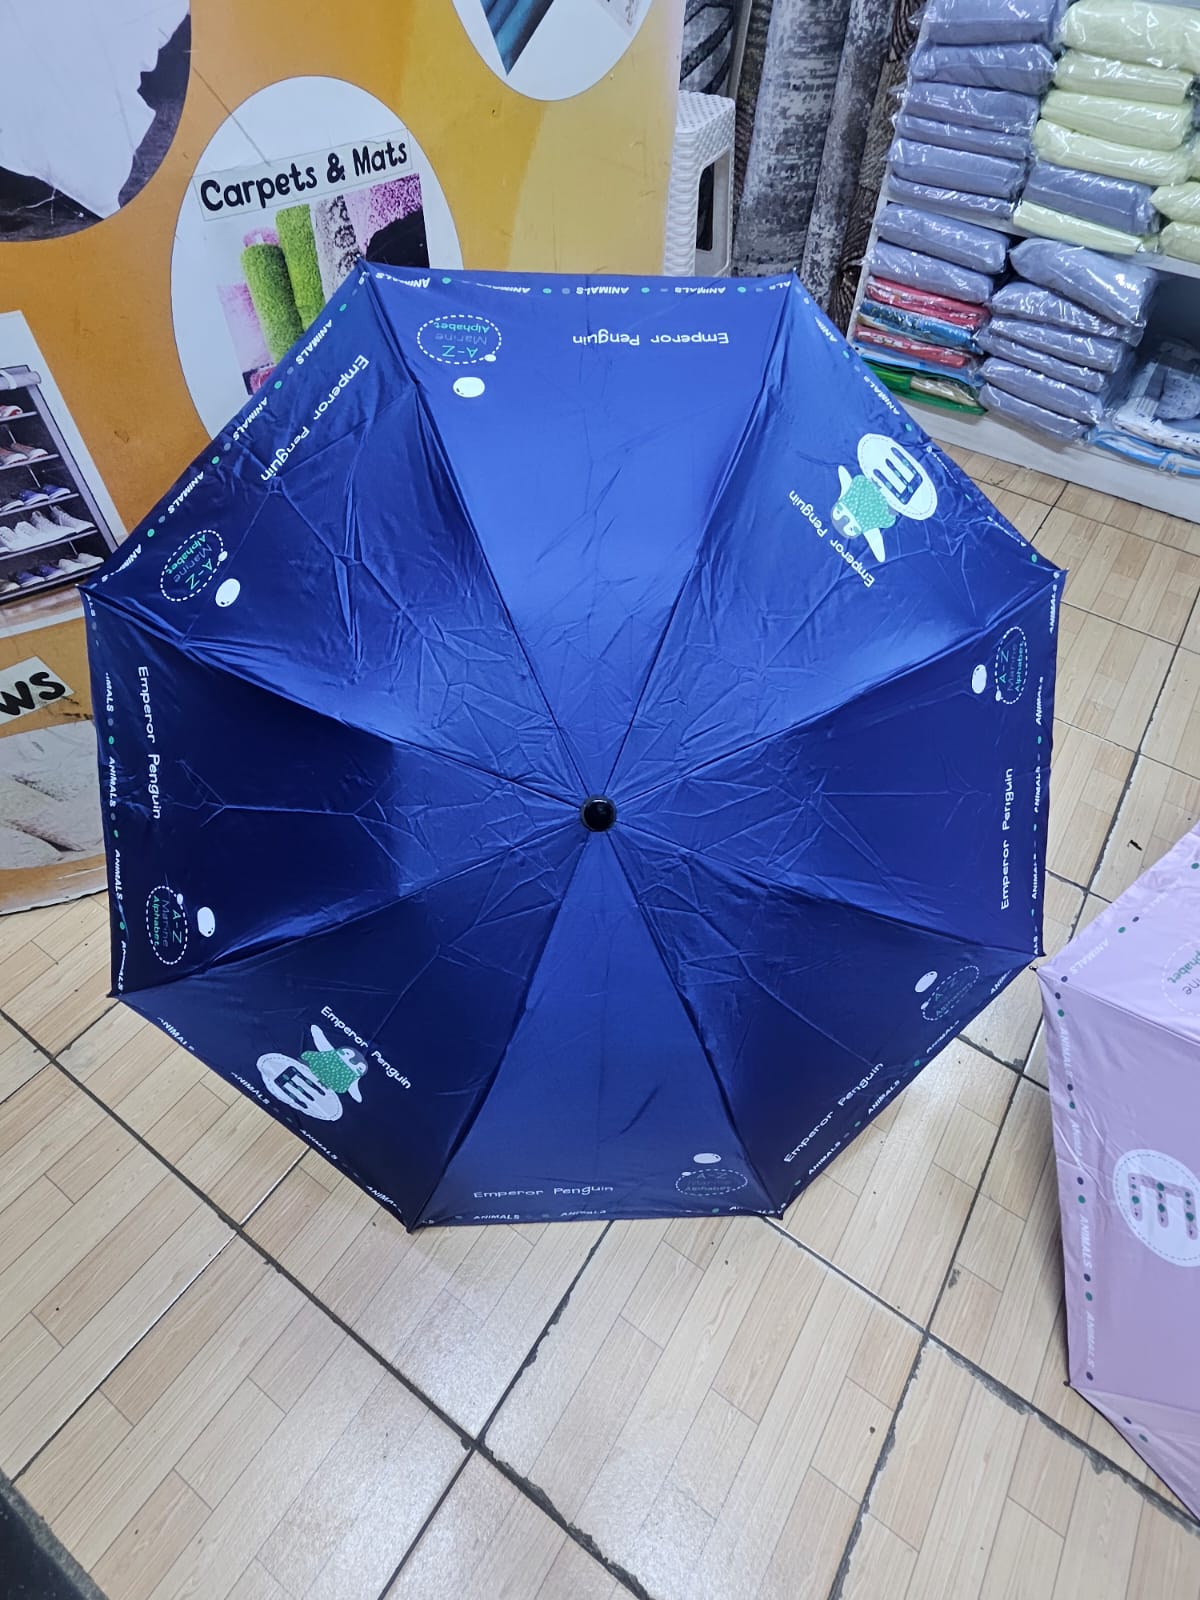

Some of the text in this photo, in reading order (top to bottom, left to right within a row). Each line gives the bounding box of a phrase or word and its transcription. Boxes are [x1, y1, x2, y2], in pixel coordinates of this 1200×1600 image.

[200, 142, 407, 209] Carpets & Mats
[576, 286, 630, 295] ANIMALS
[295, 319, 333, 365] ANIMALS
[433, 321, 490, 334] Alphabet
[435, 332, 488, 345] Marine
[572, 328, 729, 346] Emperor Penguin
[233, 397, 268, 441] ANIMALS
[260, 354, 370, 481] Emperor Penguin
[167, 471, 204, 514] ANIMALS
[166, 534, 206, 575] Alphabet
[788, 490, 876, 588] Emperor Penguin
[173, 544, 213, 583] Marine
[138, 666, 161, 819] Emperor Penguin
[108, 756, 118, 808] ANIMALS
[115, 849, 124, 900] ANIMALS
[1000, 768, 1014, 910] Emperor Penguin
[152, 895, 161, 946] Alphabet
[161, 899, 171, 948] Marine
[320, 1005, 412, 1089] Emperor Penguin
[783, 1063, 884, 1163] Emperor Penguin
[867, 1080, 900, 1115] ANIMALS
[473, 1185, 614, 1199] Emperor Penguin
